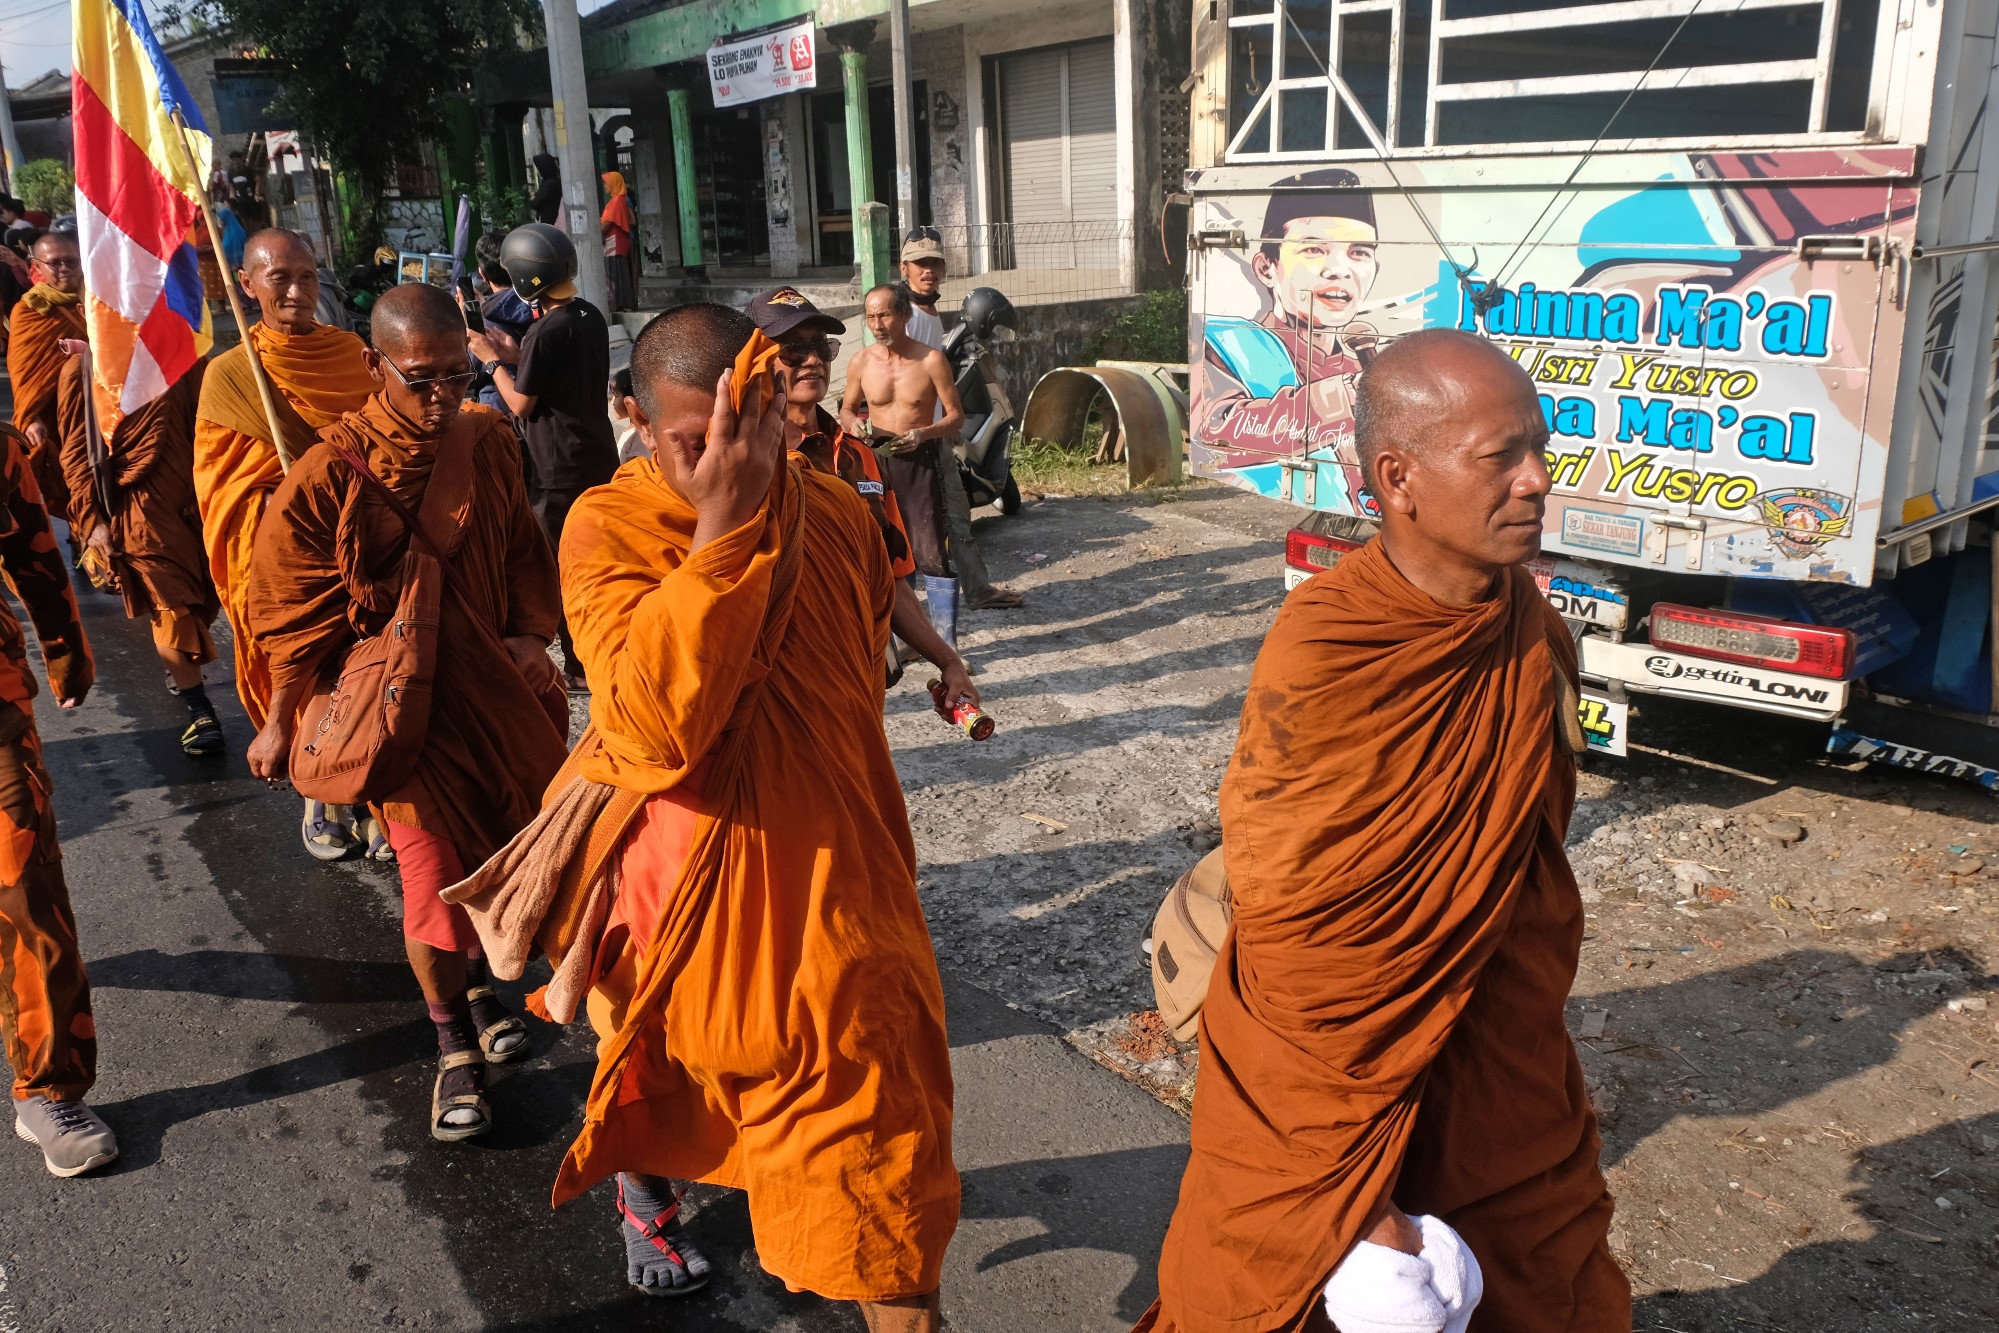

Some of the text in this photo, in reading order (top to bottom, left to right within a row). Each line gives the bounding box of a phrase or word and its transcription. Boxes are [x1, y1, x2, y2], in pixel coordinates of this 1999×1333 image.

[713, 69, 726, 81] LO
[1608, 347, 1759, 401] Yusro
[1603, 447, 1757, 511] Yusro
[1606, 525, 1637, 541] TANJUNG
